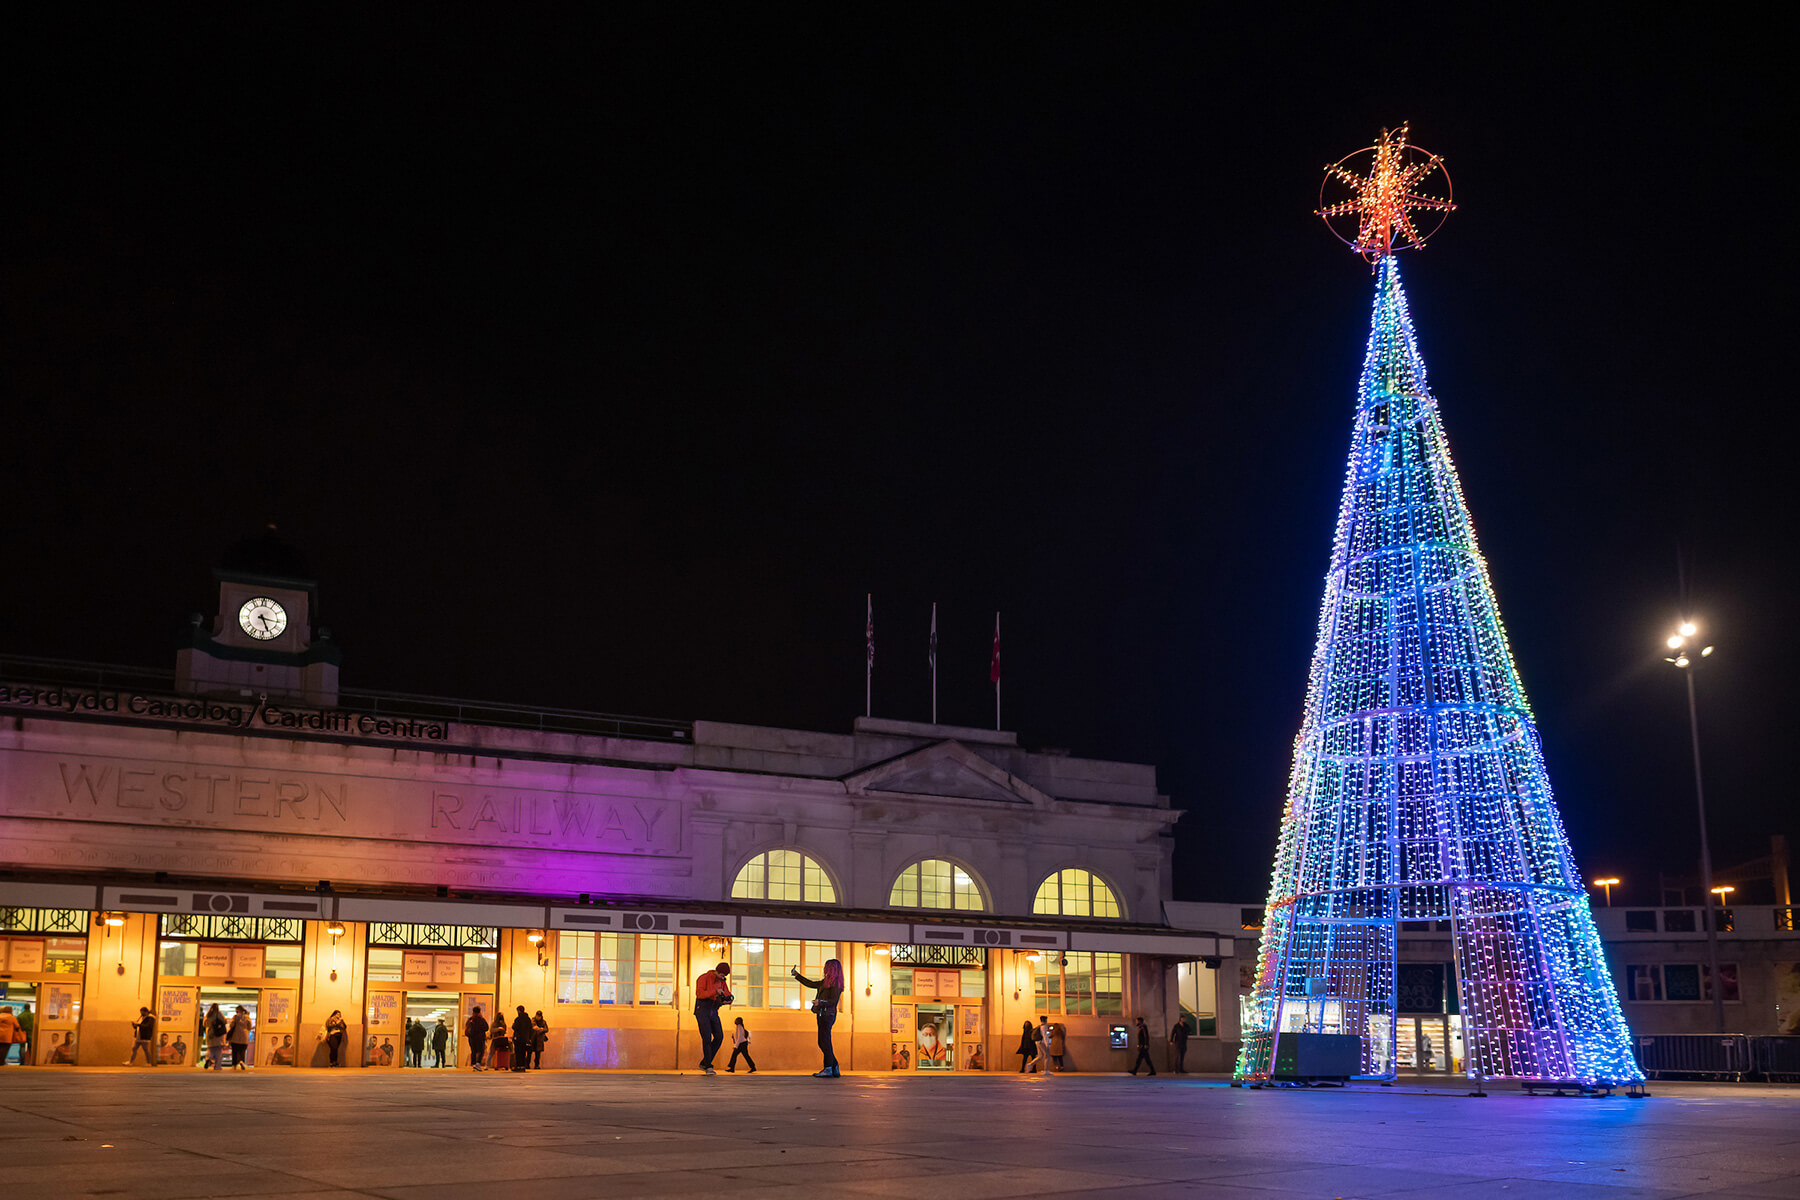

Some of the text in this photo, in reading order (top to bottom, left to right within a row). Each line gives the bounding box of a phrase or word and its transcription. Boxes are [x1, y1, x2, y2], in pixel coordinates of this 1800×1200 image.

[357, 713, 448, 741] Central
[58, 762, 667, 842] WESTERN RAILWAY
